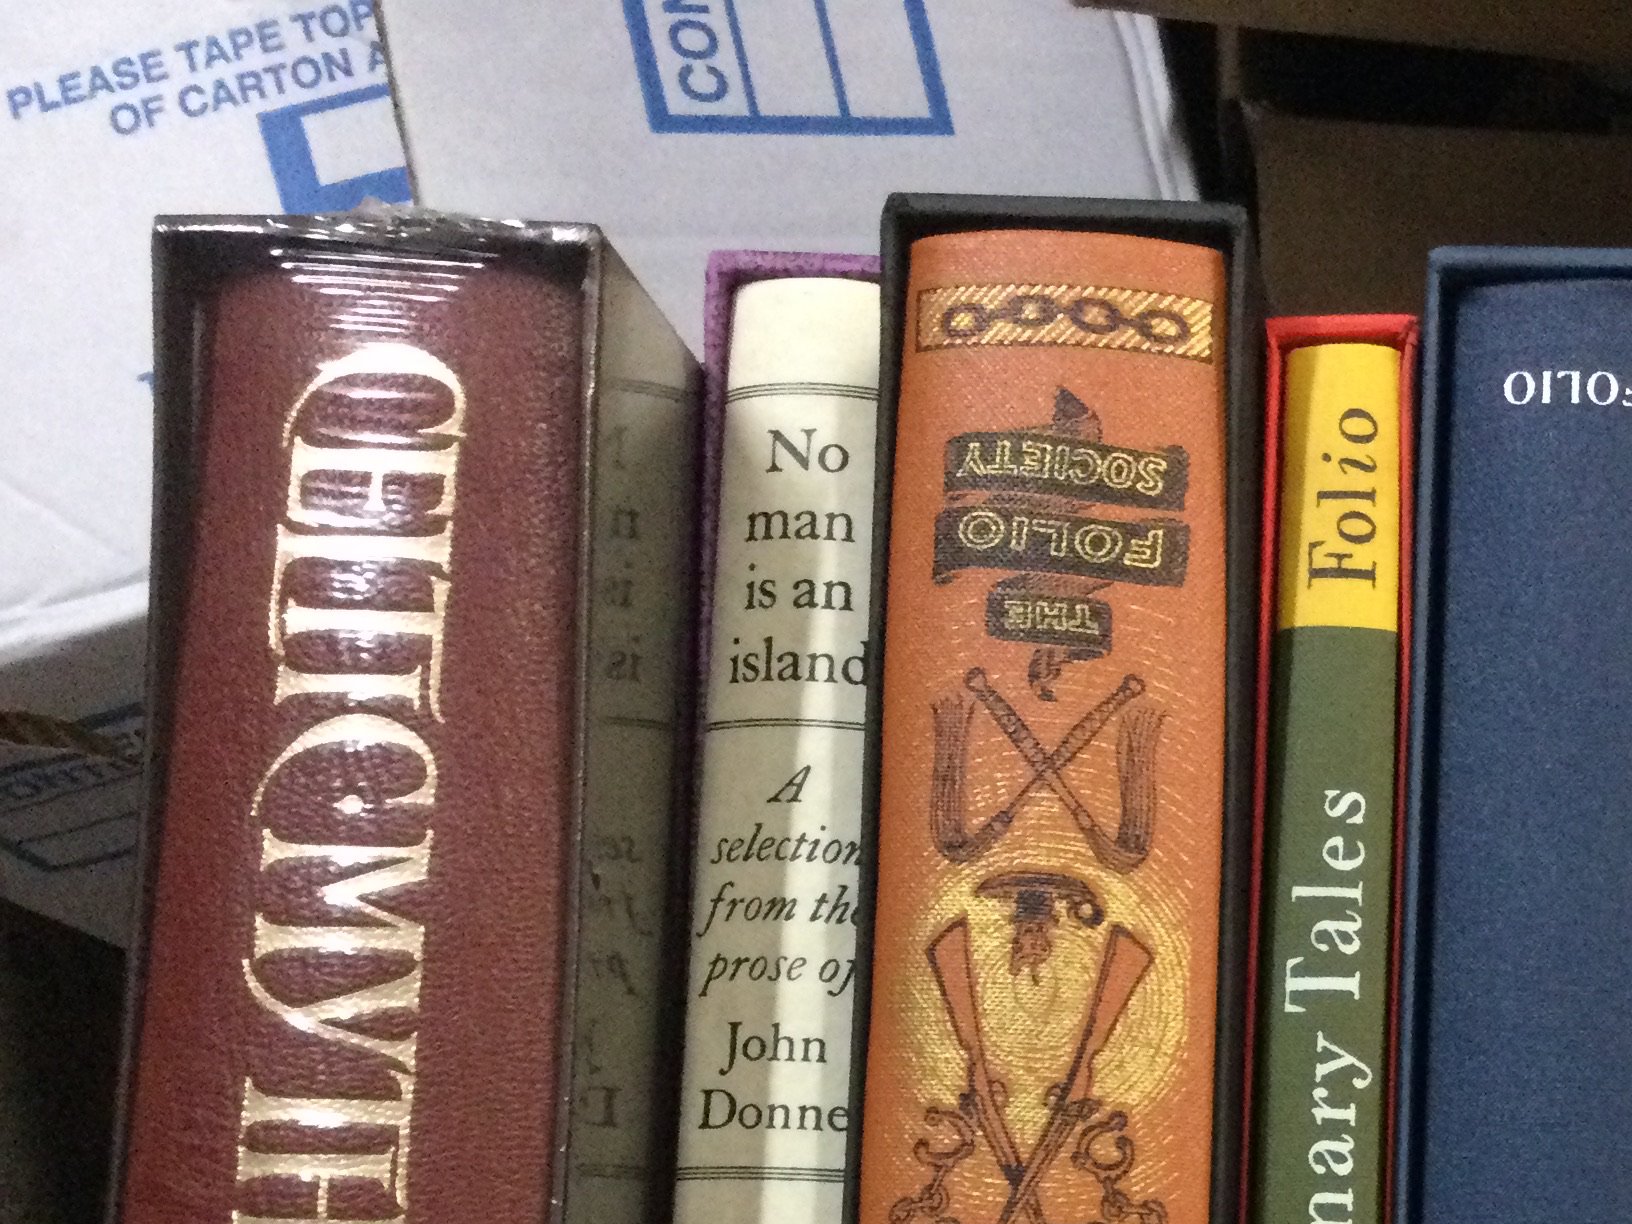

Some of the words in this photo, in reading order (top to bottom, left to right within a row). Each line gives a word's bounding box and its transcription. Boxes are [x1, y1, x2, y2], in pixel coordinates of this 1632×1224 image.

[5, 49, 170, 120] PLEASE
[174, 19, 285, 73] TAPE
[290, 0, 375, 43] TOP
[109, 95, 165, 136] OF
[178, 48, 354, 117] CARTON
[766, 428, 850, 473] No
[956, 440, 1167, 496] SOCIETY
[1307, 407, 1380, 590] Folio
[745, 508, 855, 543] man
[958, 511, 1164, 568] FOLIO
[744, 563, 777, 611] is
[792, 577, 854, 612] an
[1003, 600, 1100, 634] THE
[728, 636, 872, 686] island
[766, 765, 811, 803] A
[696, 881, 796, 937] from
[1284, 788, 1366, 1014] Tales
[699, 952, 807, 997] prose
[719, 1022, 828, 1075] John
[697, 1088, 850, 1132] Donne
